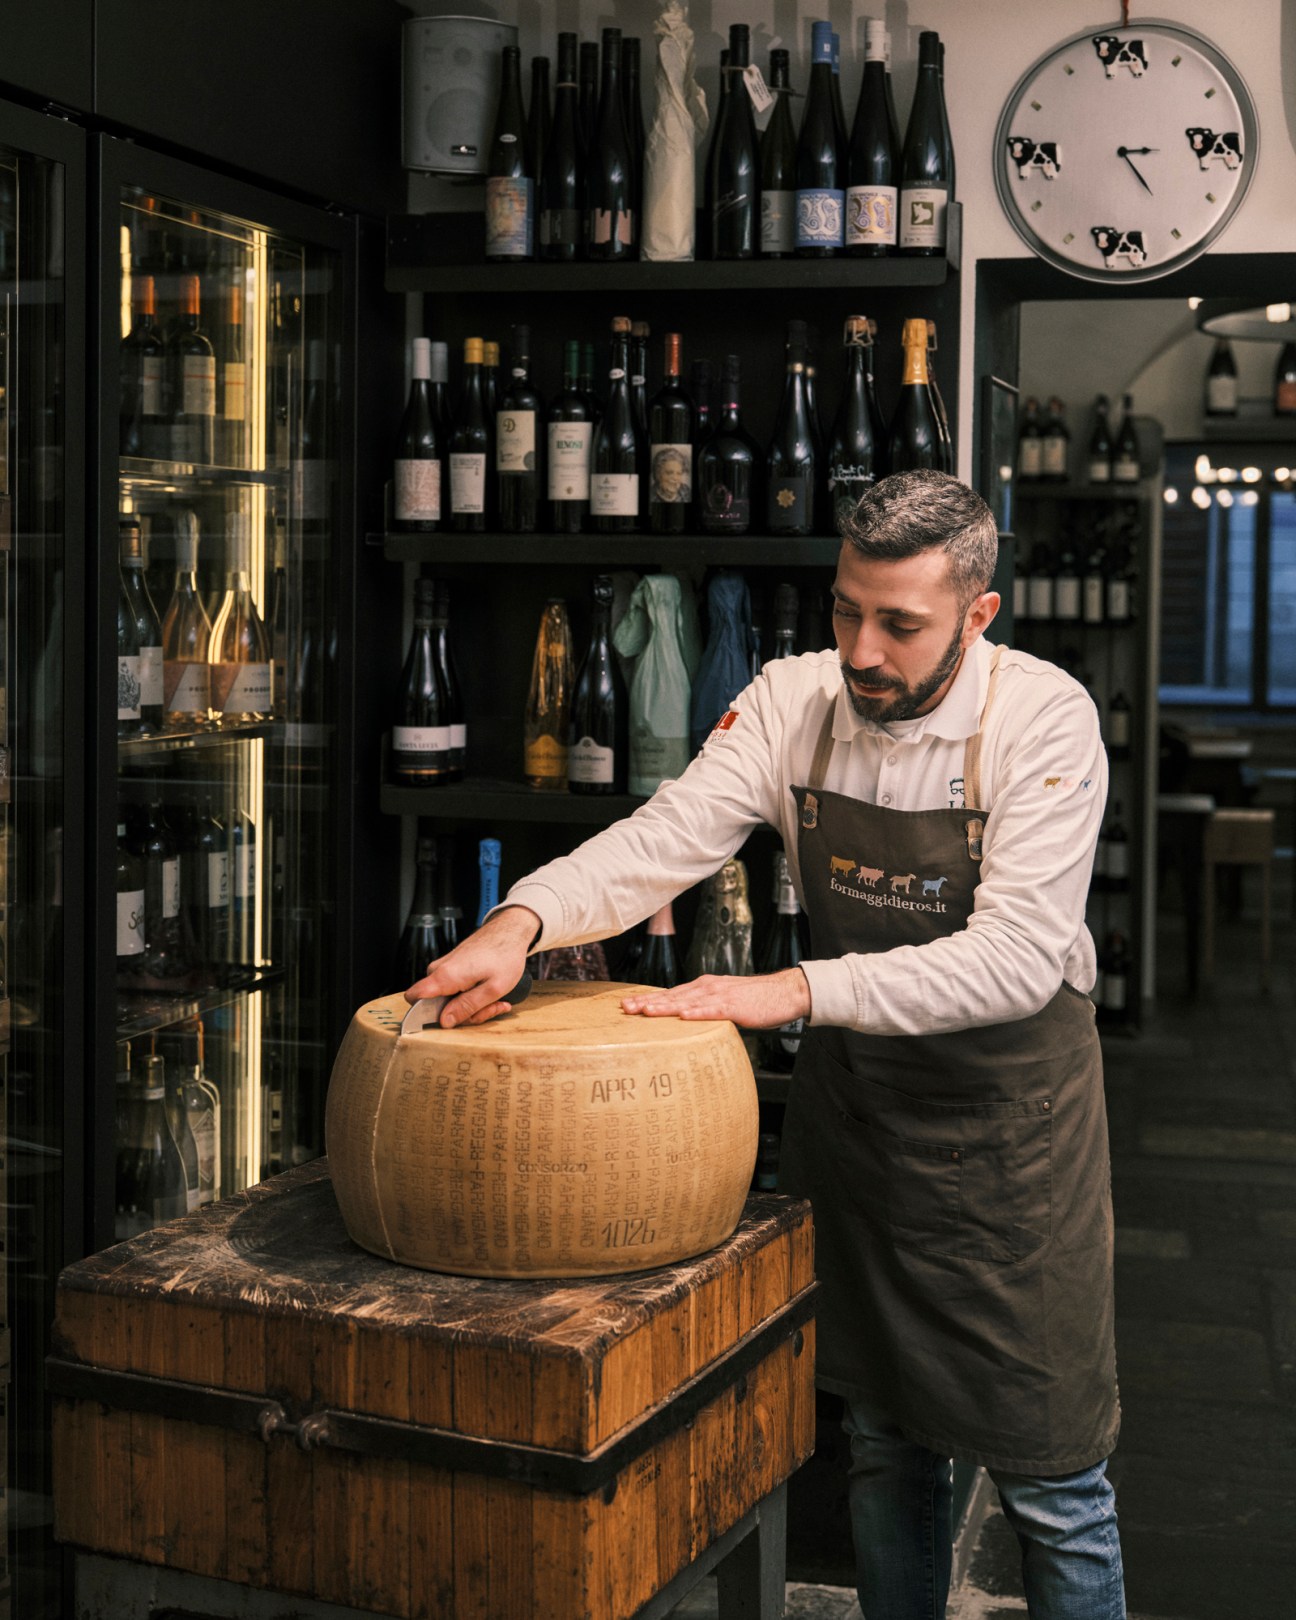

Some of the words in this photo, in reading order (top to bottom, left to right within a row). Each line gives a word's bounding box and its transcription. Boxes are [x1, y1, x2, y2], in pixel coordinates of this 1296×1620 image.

[829, 877, 947, 913] formaggidieros.it
[591, 1077, 635, 1104] APR
[648, 1072, 673, 1099] 19
[471, 1078, 490, 1161] REGGIANO
